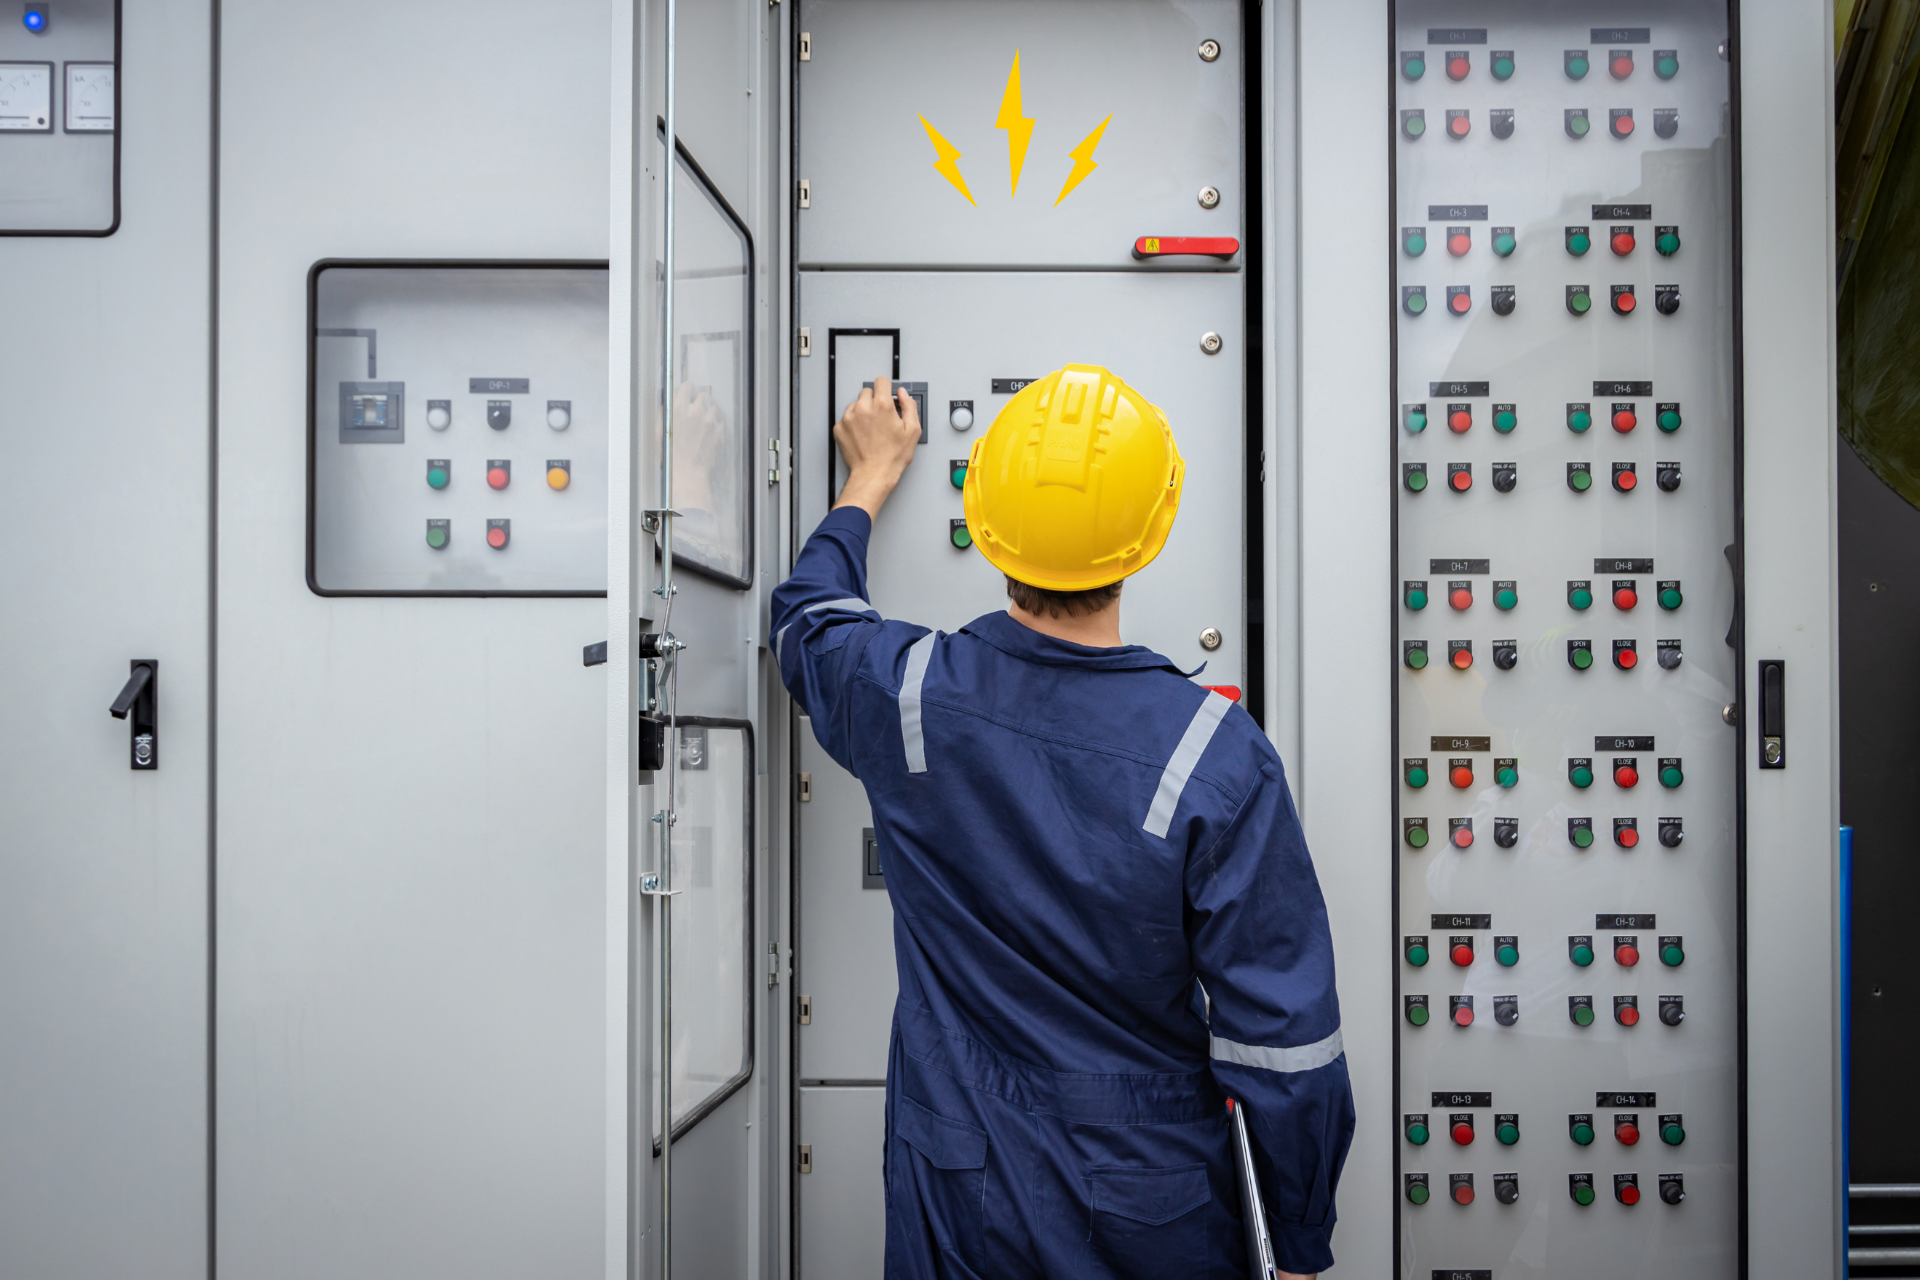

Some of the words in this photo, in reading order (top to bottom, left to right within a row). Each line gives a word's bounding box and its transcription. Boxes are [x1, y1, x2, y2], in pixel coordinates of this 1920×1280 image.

[1450, 32, 1466, 40] CH-1
[1450, 209, 1467, 217] CH-3
[1451, 385, 1468, 393] CH-5
[1614, 385, 1631, 393] CH-6
[1452, 562, 1468, 570] CH-7
[1616, 562, 1632, 570] CH-8
[1615, 740, 1634, 748] CH-10
[1452, 918, 1470, 926] CH-11
[1616, 918, 1635, 926] CH-12
[1452, 1095, 1471, 1104] CH-13
[1616, 1095, 1635, 1104] CH-14
